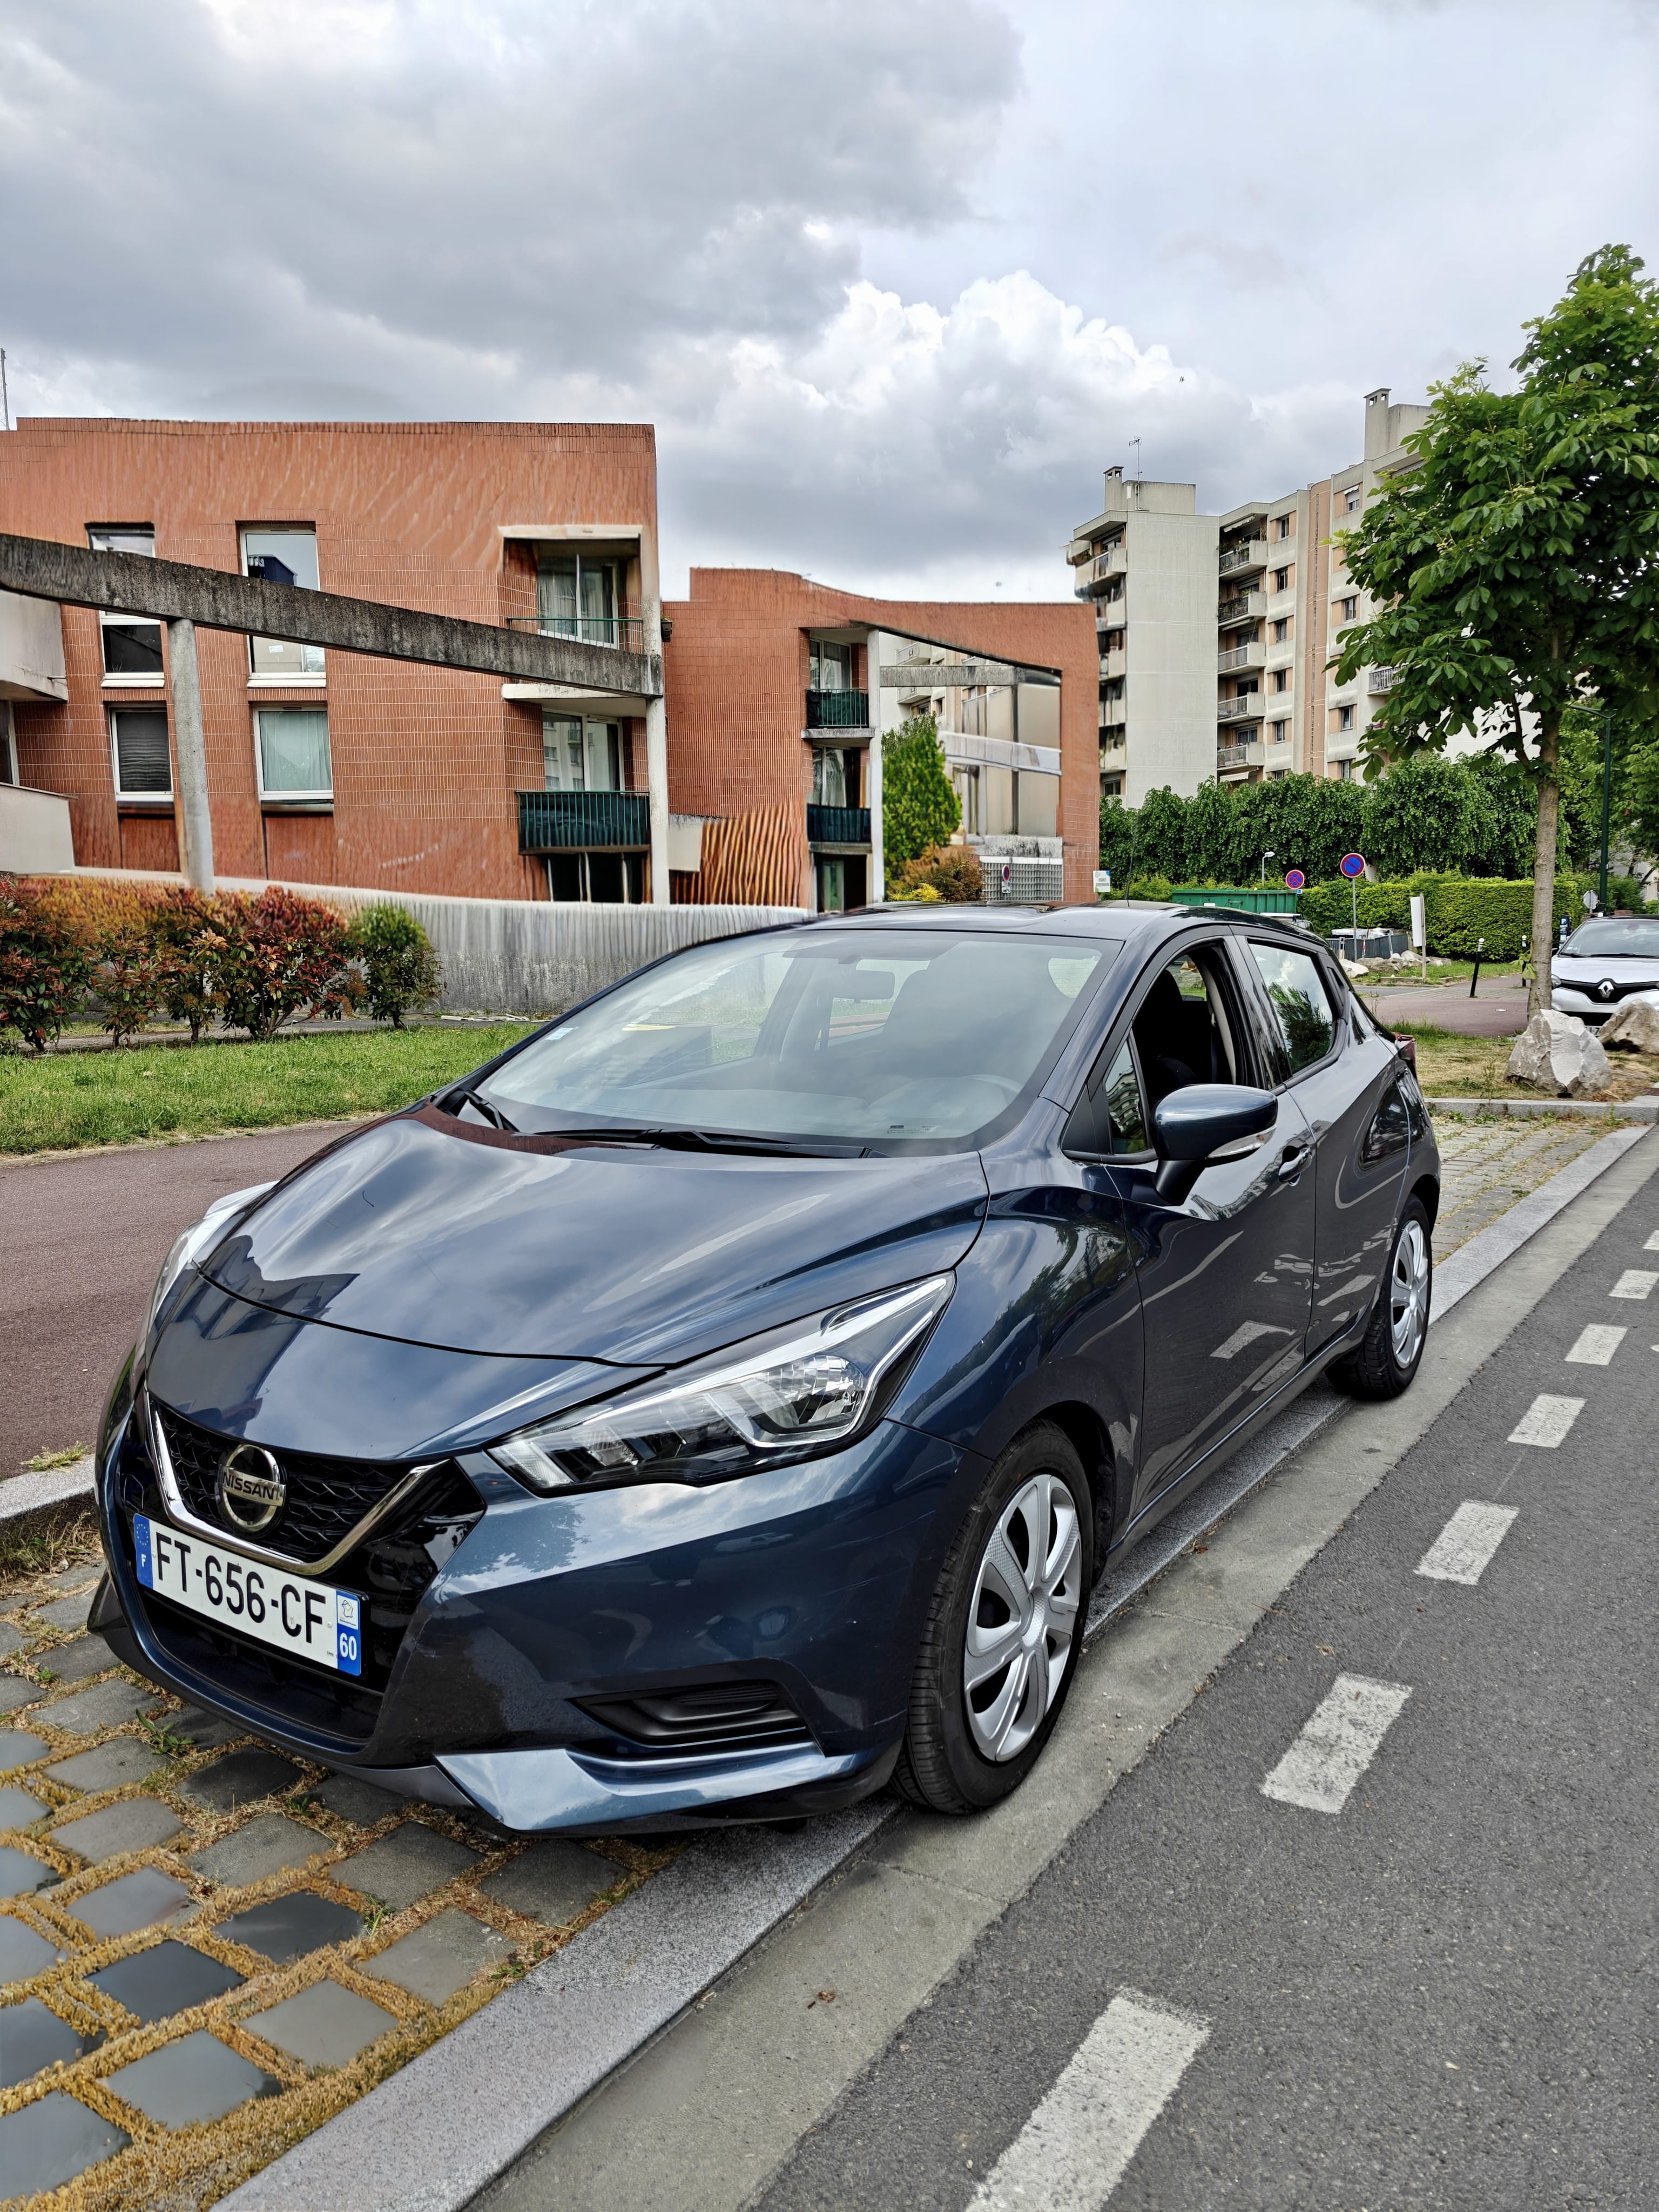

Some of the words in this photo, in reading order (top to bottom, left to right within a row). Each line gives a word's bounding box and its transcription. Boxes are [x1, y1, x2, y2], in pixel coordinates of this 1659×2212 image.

[222, 1472, 274, 1500] NISSAN
[141, 1553, 146, 1567] F
[156, 1532, 326, 1643] FT-656-CF
[340, 1633, 357, 1661] 60
